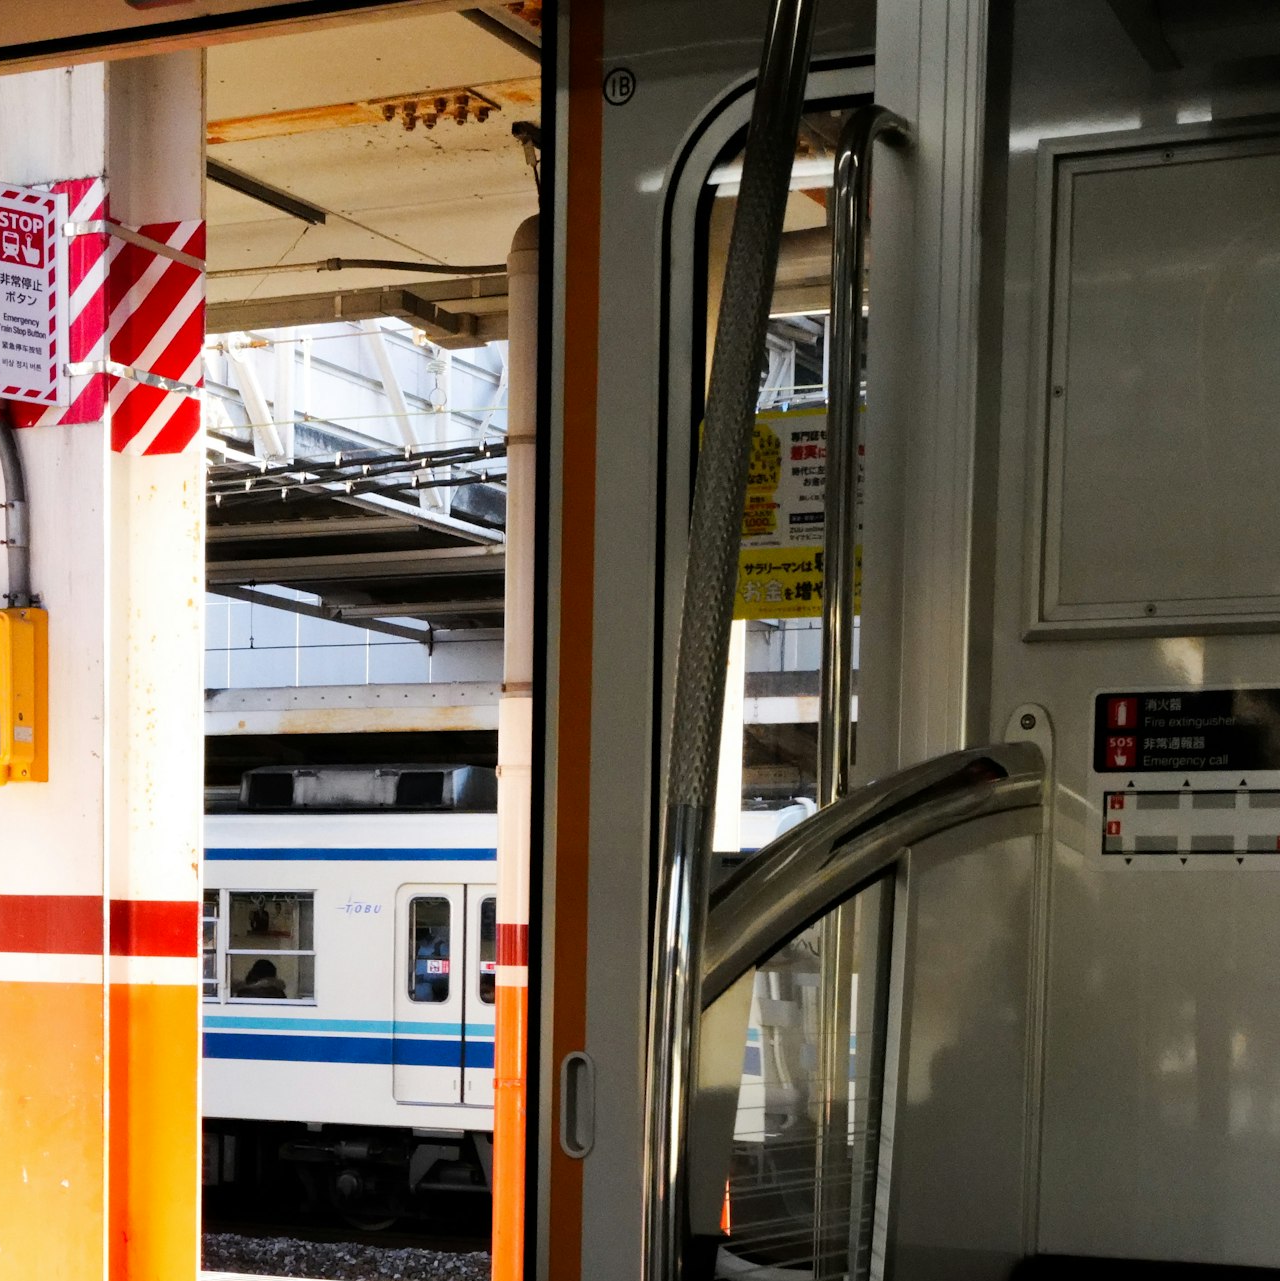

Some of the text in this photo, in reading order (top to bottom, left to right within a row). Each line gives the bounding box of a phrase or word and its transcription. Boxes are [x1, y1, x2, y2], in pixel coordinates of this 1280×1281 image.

[612, 76, 630, 97] 1B
[0, 211, 44, 234] STOP
[0, 273, 43, 293] 非常停止
[5, 291, 37, 306] ボタン
[3, 312, 39, 328] Emergency
[13, 326, 27, 336] Stop
[27, 329, 47, 339] Button
[1145, 698, 1182, 712] 消火器
[1144, 716, 1237, 729] Fire extinguisher
[1109, 738, 1134, 747] SOS
[1143, 736, 1205, 750] 非常通報器
[1143, 754, 1229, 767] Emergency call
[345, 904, 382, 914] TOBU
